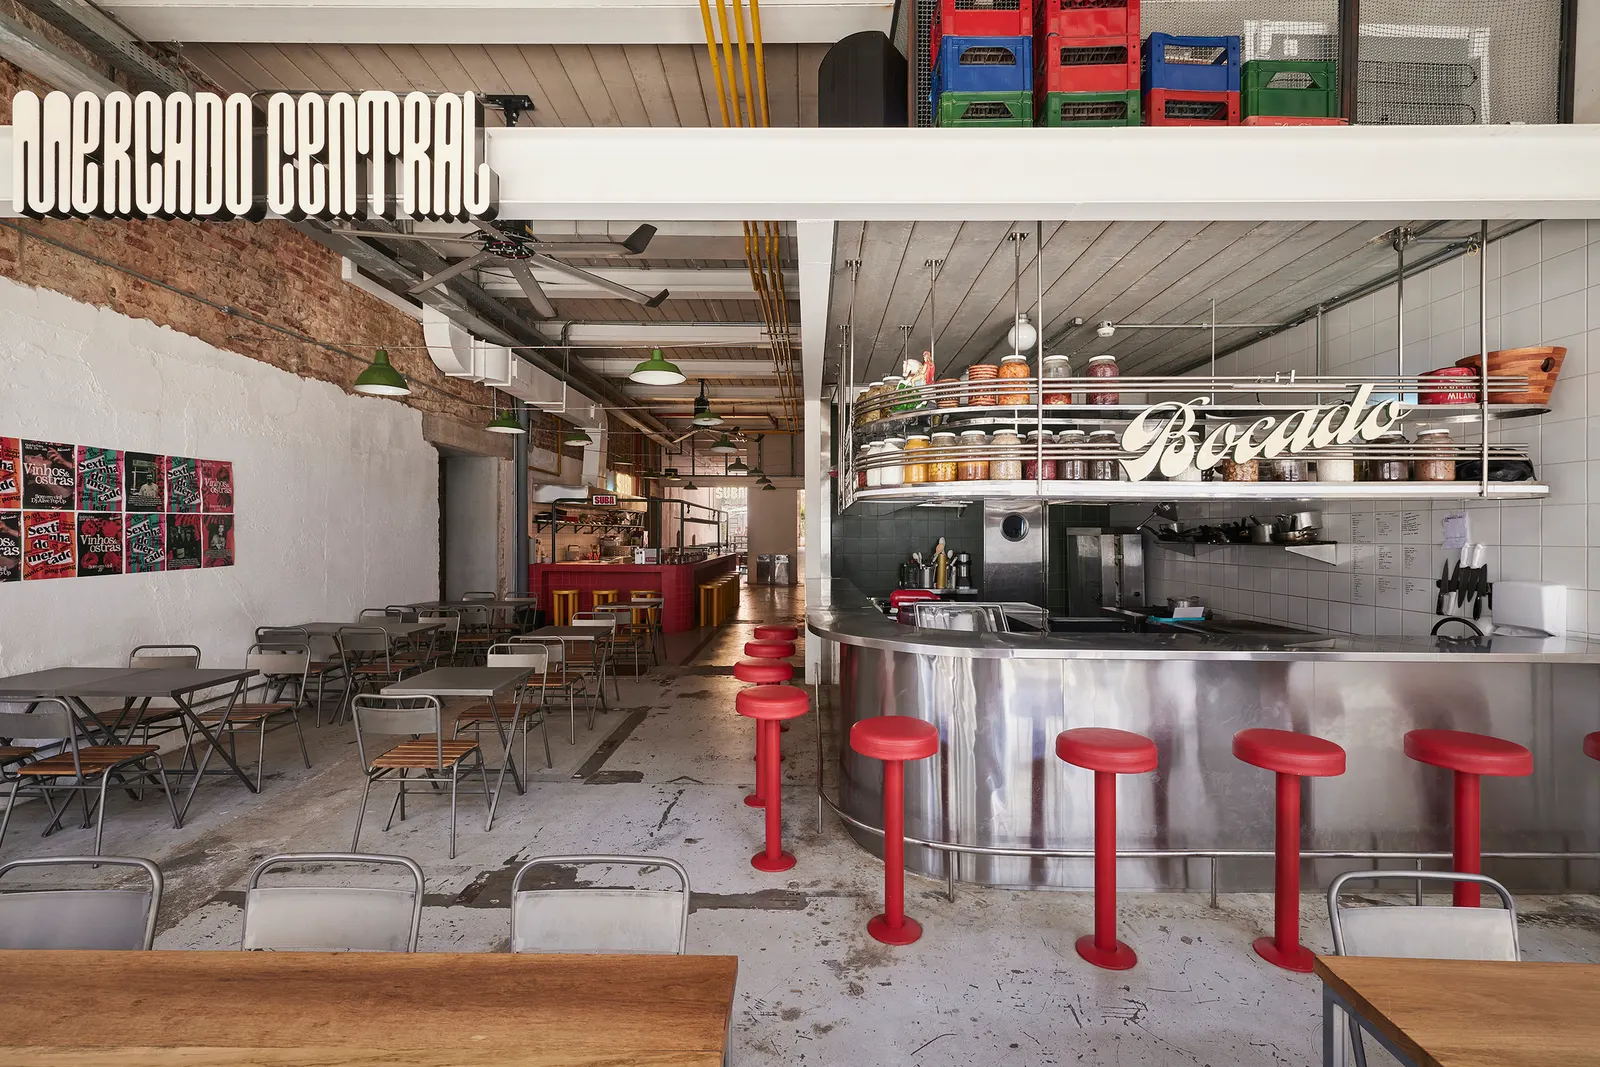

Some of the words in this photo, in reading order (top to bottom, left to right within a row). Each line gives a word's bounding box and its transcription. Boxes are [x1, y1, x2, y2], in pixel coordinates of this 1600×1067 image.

[1447, 392, 1477, 400] MILANO
[1118, 383, 1412, 482] Bocado
[78, 457, 106, 471] Sexti
[35, 475, 74, 486] ostras
[594, 496, 615, 505] SUBA
[28, 522, 59, 536] Sexti
[50, 533, 71, 543] nha
[33, 539, 49, 549] do
[90, 544, 121, 553] ostras
[28, 551, 54, 562] mer
[46, 550, 72, 565] cado
